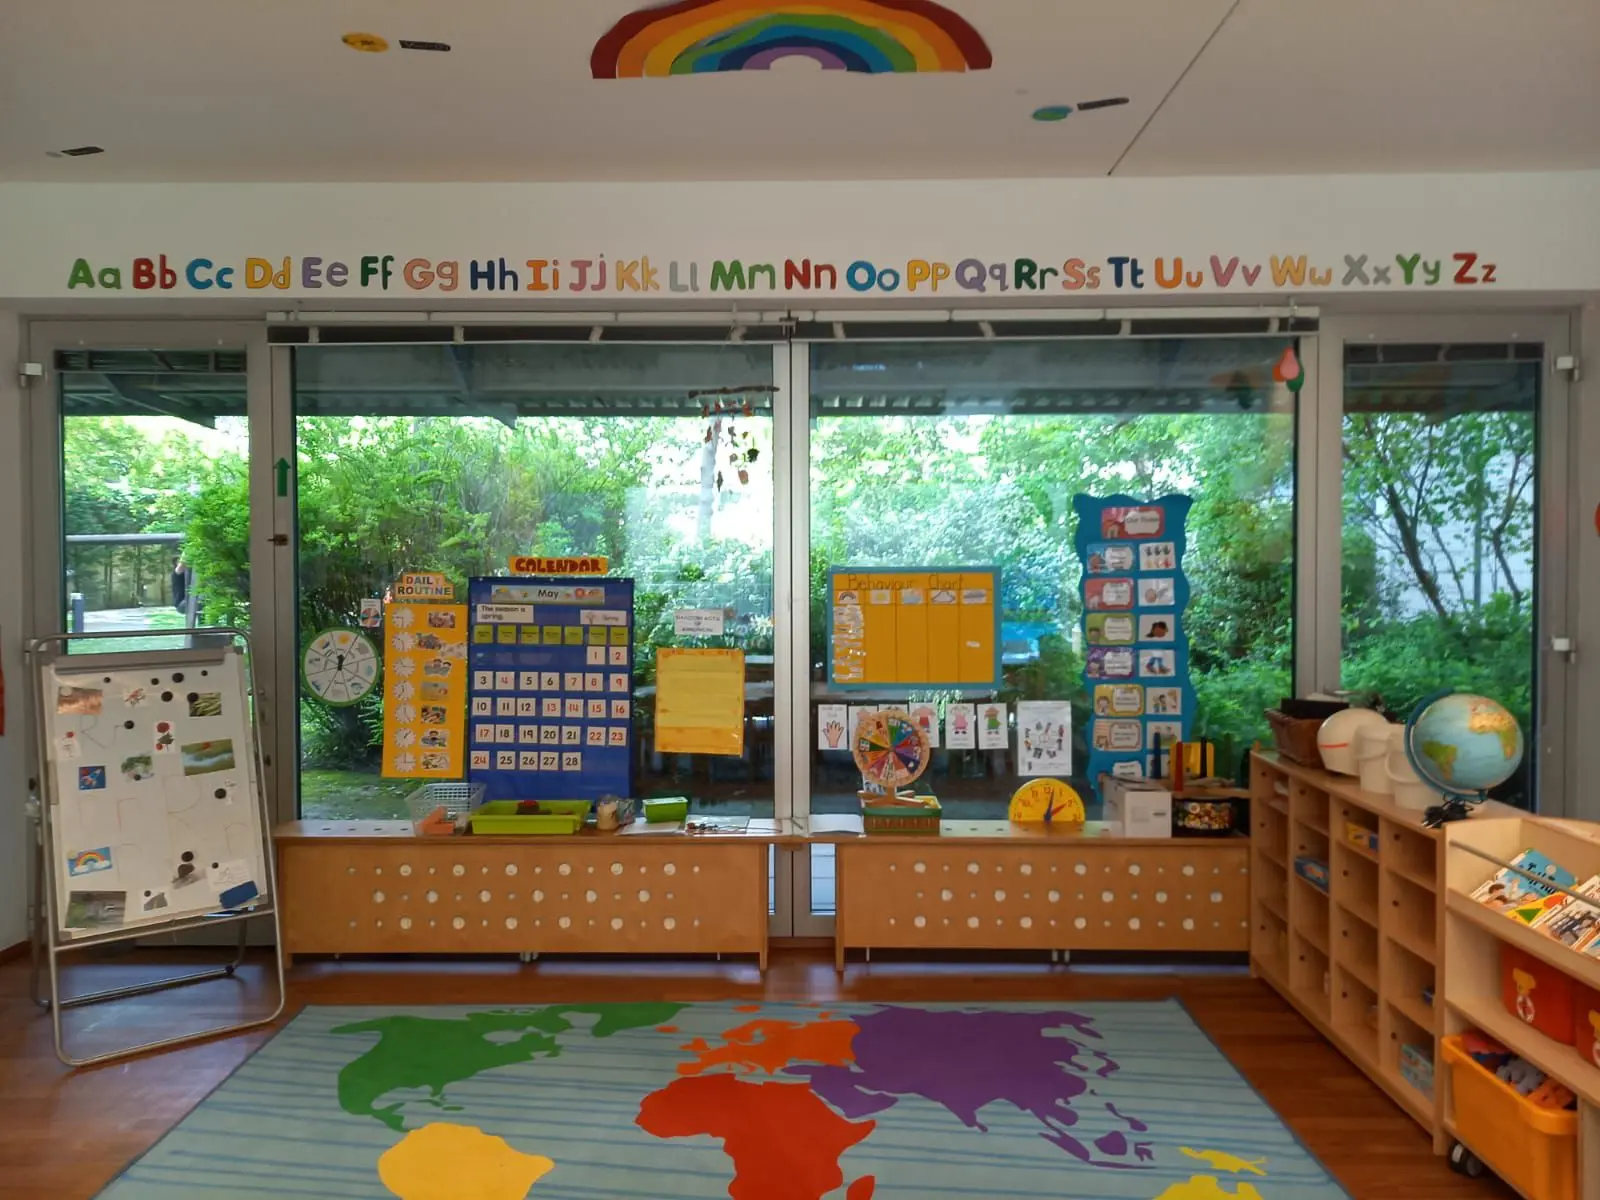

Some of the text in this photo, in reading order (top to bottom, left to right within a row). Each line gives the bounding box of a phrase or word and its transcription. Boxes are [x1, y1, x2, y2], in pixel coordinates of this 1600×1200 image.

[67, 252, 1496, 292] Aa Bb Cc Dd Ee Ff Gg Hh Ii Jj Kk Ll Mm Nn Oo Pp Qq Rr Ss Tt Uu Vv Ww Xx Yy Zz
[515, 558, 602, 573] CALENDAR
[847, 573, 964, 589] Behaviour Chart
[397, 586, 452, 596] ROUTINE
[537, 589, 559, 599] May
[615, 652, 621, 660] 2
[480, 676, 622, 688] 3 4 5 6 7 8 9
[476, 702, 625, 714] 10 11 12 13 14 15 16
[479, 729, 624, 741] 17 18 19 20 21 22 23
[473, 756, 578, 766] 24 25 26 27 28
